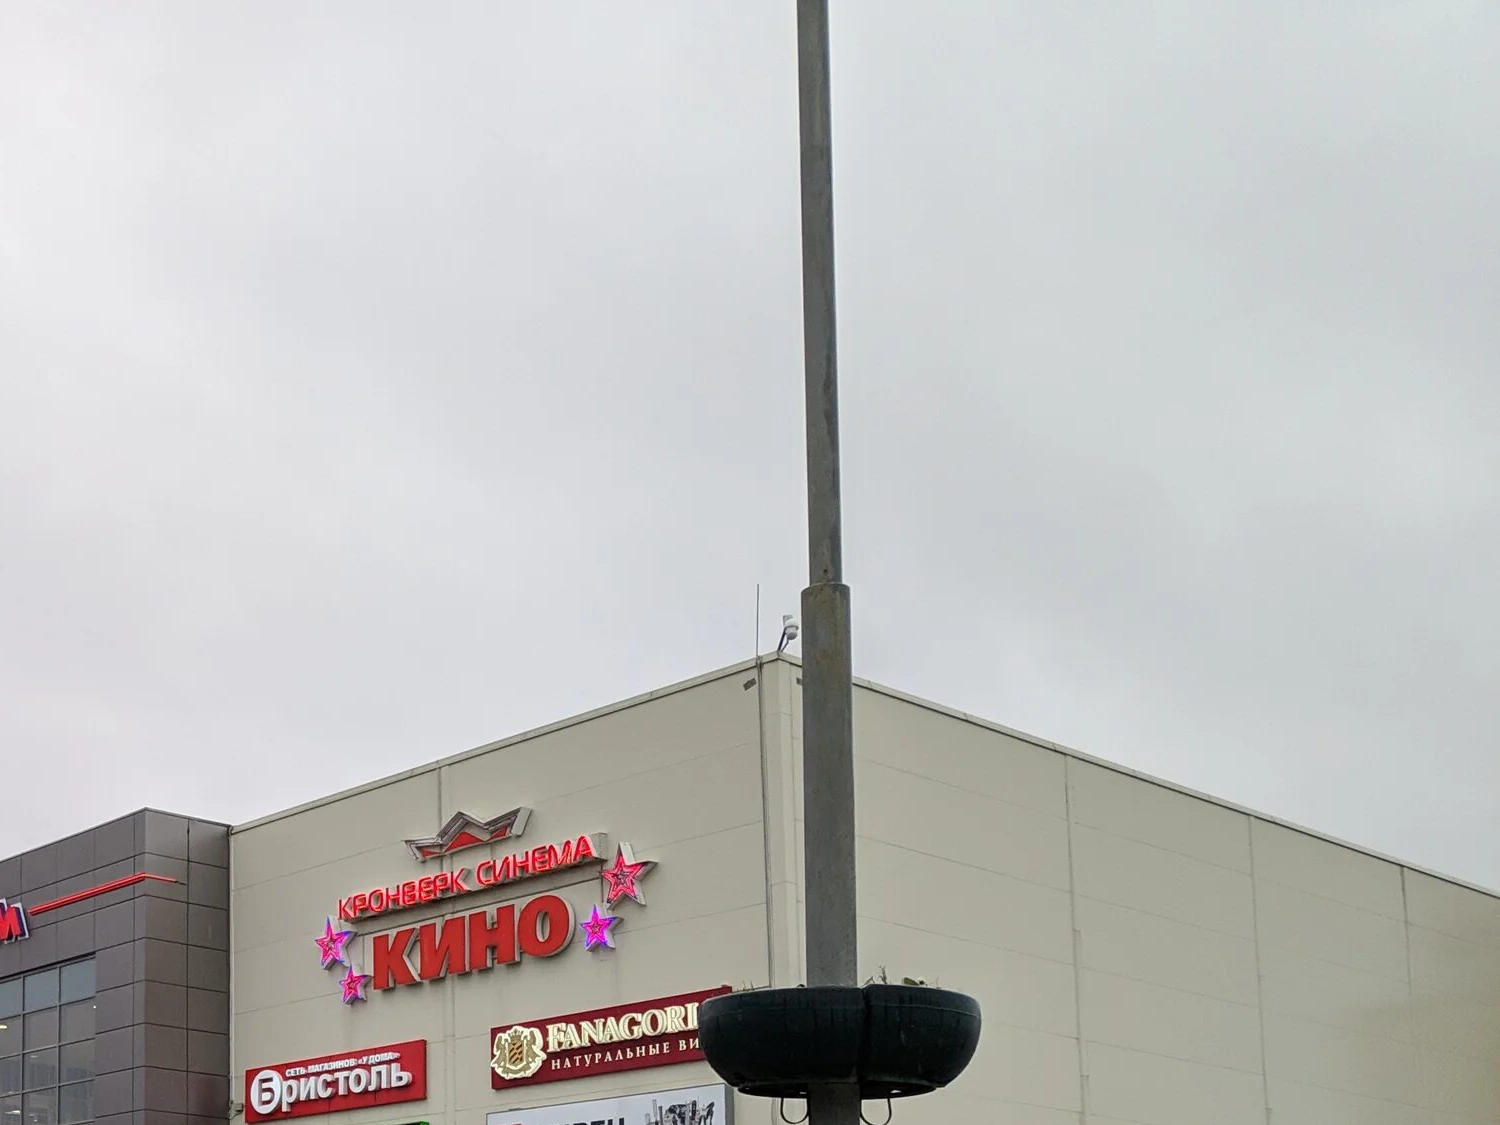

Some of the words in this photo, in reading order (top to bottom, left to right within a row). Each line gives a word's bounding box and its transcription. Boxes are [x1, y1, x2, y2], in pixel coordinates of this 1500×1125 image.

[338, 866, 469, 920] КРОНВЕРК
[476, 835, 595, 886] СИНЕМА
[373, 894, 573, 990] КИНО
[546, 1002, 700, 1053] FANAGORI
[551, 1043, 671, 1070] НАТУРАЛЬНЫЕ
[678, 1037, 700, 1052] ВИ
